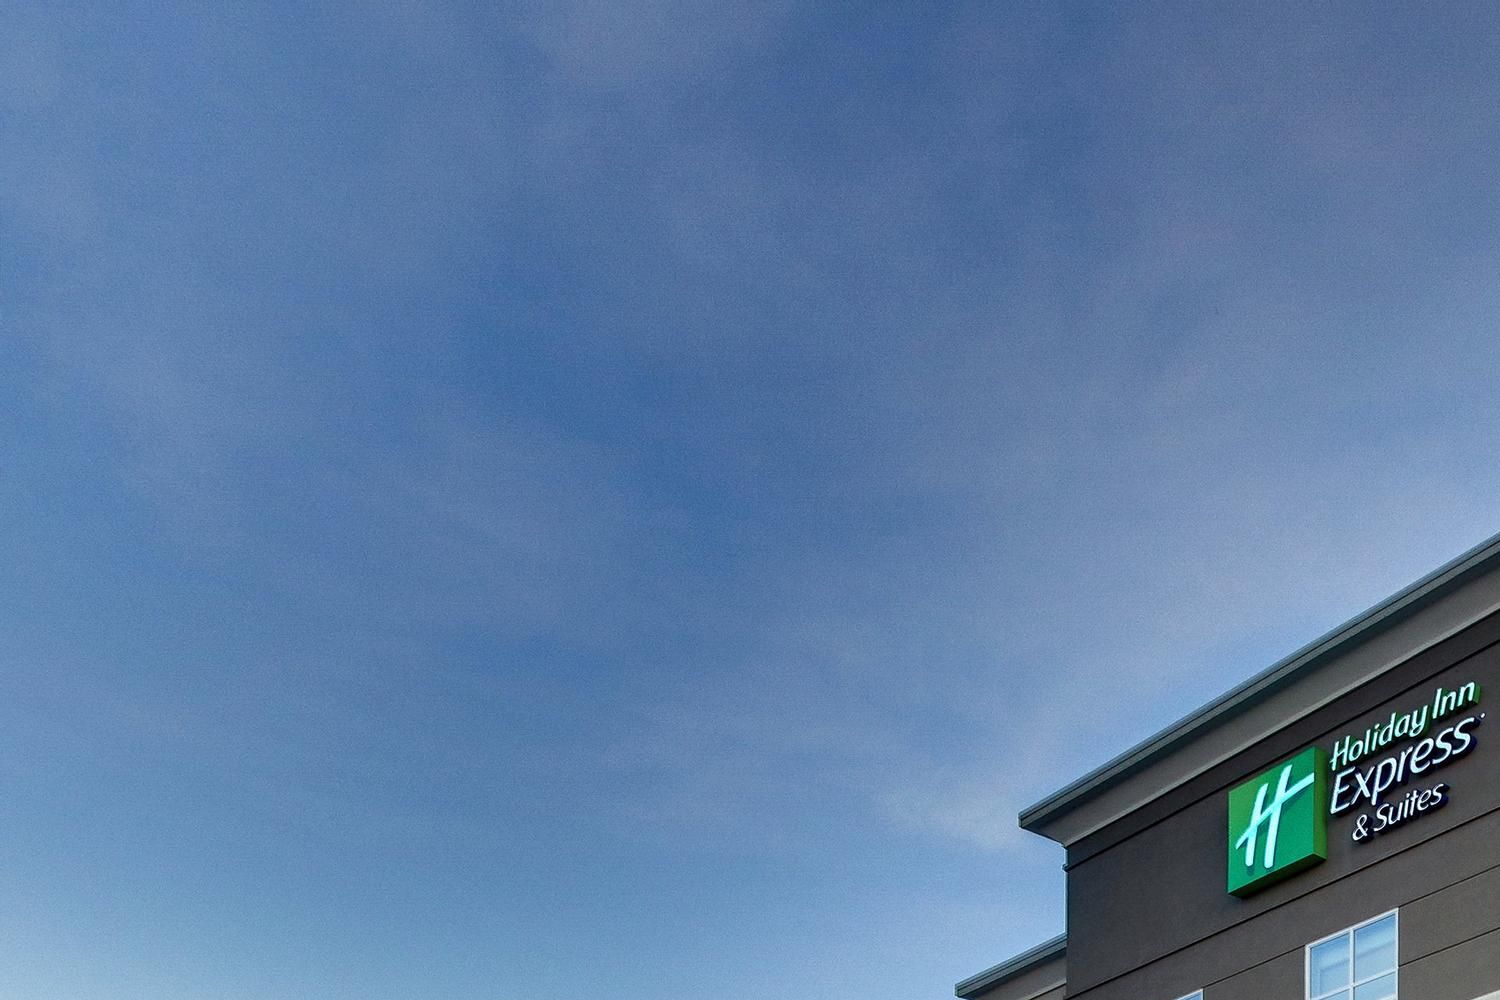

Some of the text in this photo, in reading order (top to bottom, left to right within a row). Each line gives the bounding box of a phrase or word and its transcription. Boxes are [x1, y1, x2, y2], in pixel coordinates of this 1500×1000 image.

[1329, 681, 1476, 771] Holiday Inn
[1330, 717, 1475, 815] Express
[1352, 783, 1445, 841] & Suites
